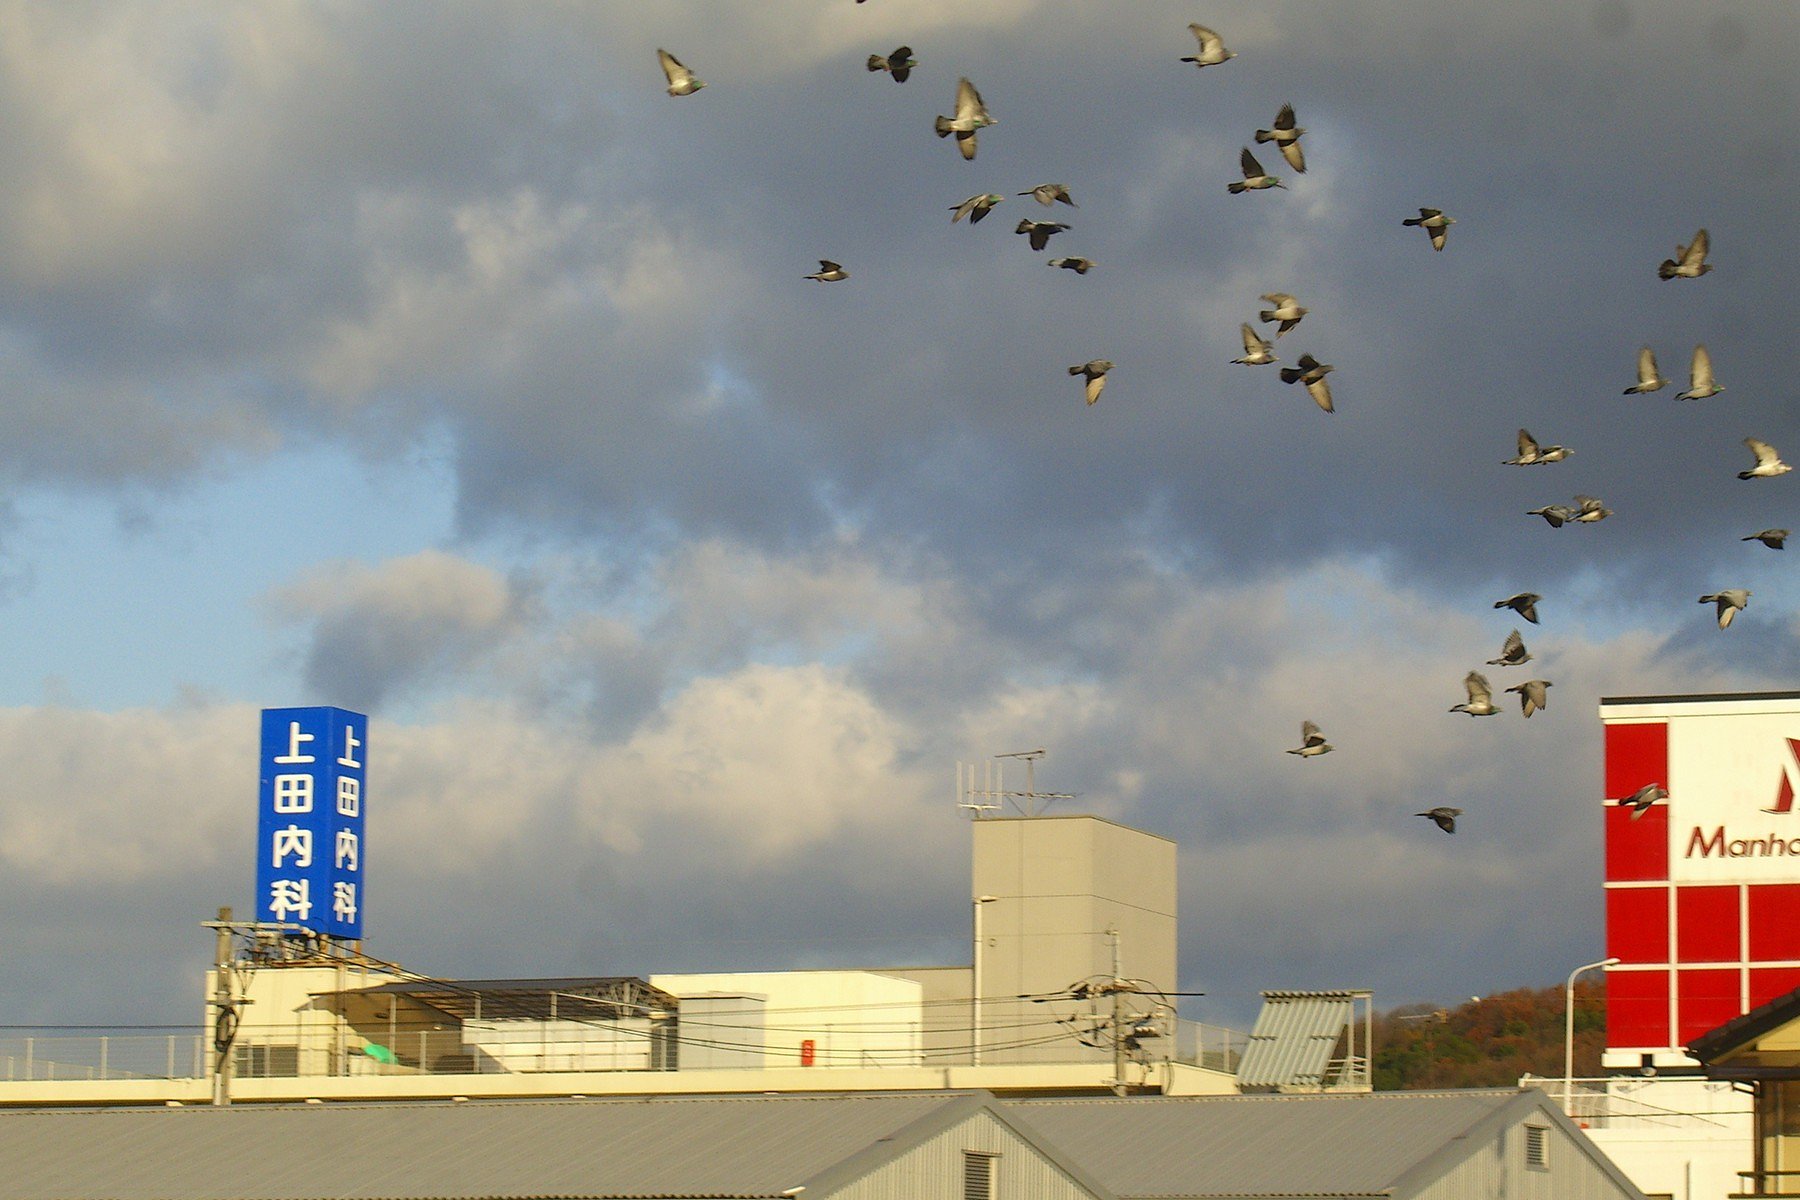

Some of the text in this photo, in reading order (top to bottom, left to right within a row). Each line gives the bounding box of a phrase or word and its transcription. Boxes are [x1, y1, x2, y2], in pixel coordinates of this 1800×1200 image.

[269, 721, 316, 921] 上田内科
[333, 725, 361, 924] 上田内科
